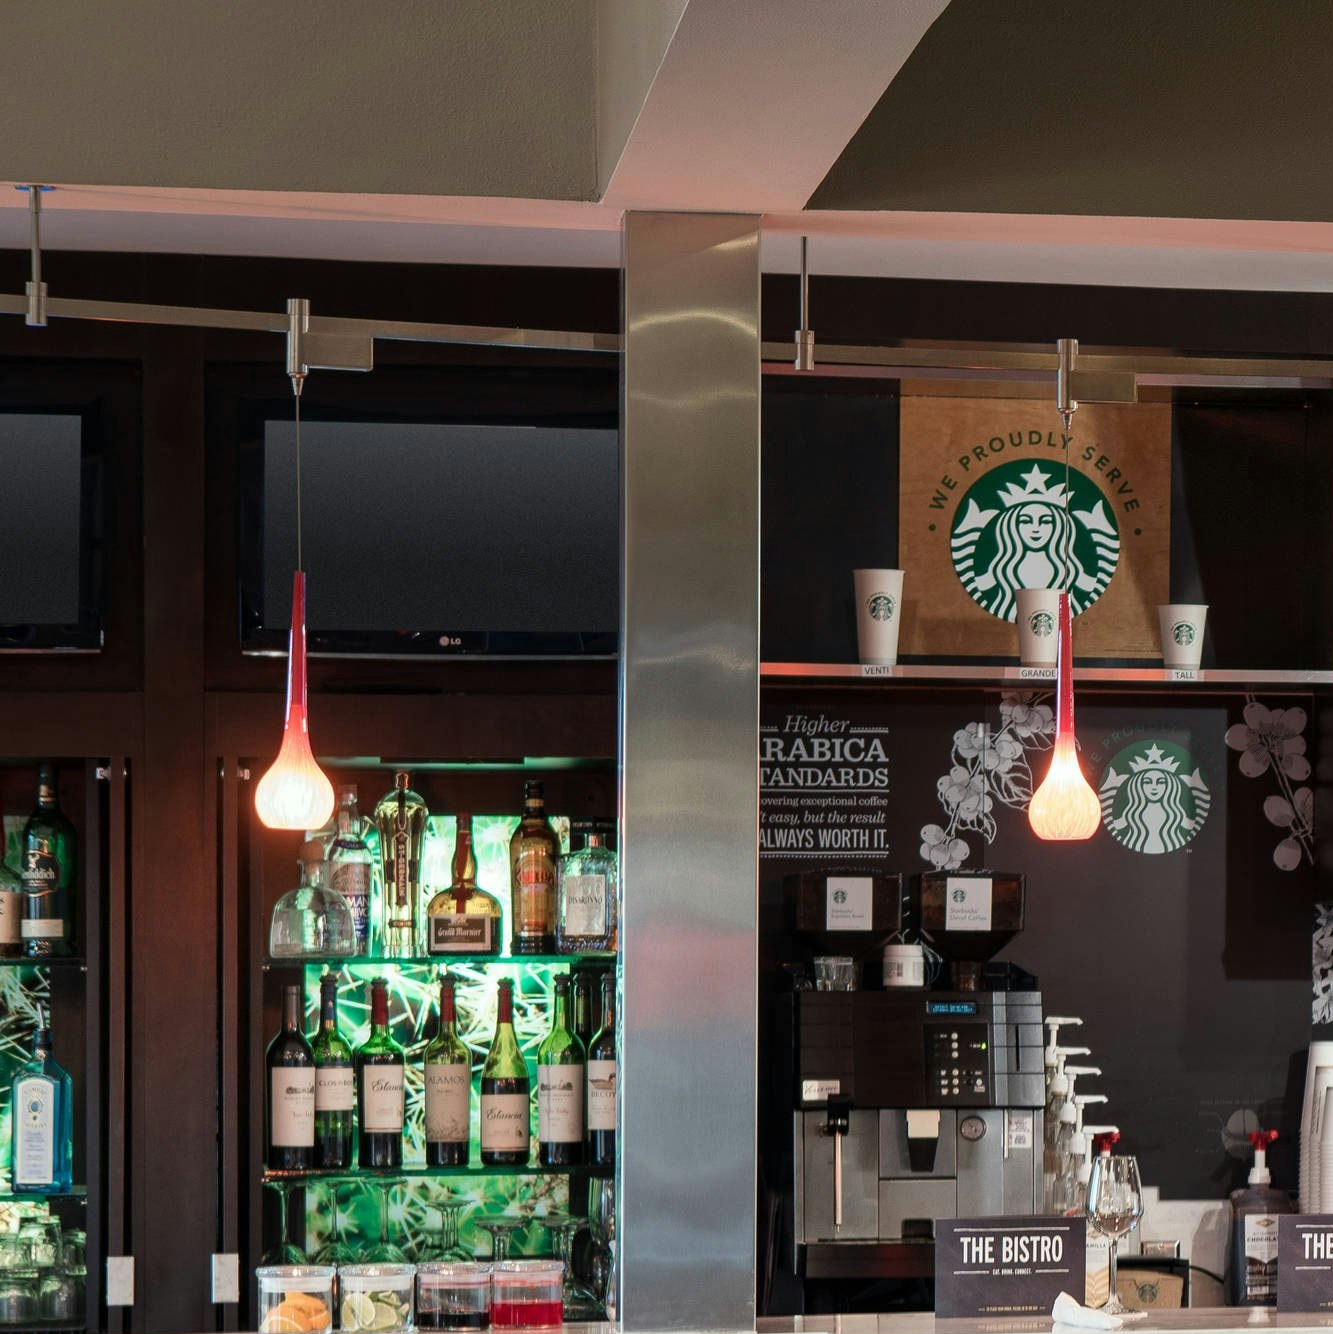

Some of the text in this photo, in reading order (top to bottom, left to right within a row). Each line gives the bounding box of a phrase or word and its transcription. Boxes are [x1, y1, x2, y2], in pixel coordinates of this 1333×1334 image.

[929, 430, 1140, 512] WE PROUDLY SERVE
[864, 666, 890, 676] VENTI
[1021, 669, 1056, 678] GRANDE
[1175, 671, 1194, 679] TALL
[783, 715, 850, 736] Higher
[760, 738, 889, 762] RABICA
[801, 796, 888, 807] exceptional coffee
[769, 811, 886, 825] easy, but the result
[760, 828, 889, 848] ALWAYS WORTH IT.
[428, 1076, 465, 1085] ALAMOS
[960, 1235, 1063, 1264] THE BISTRO
